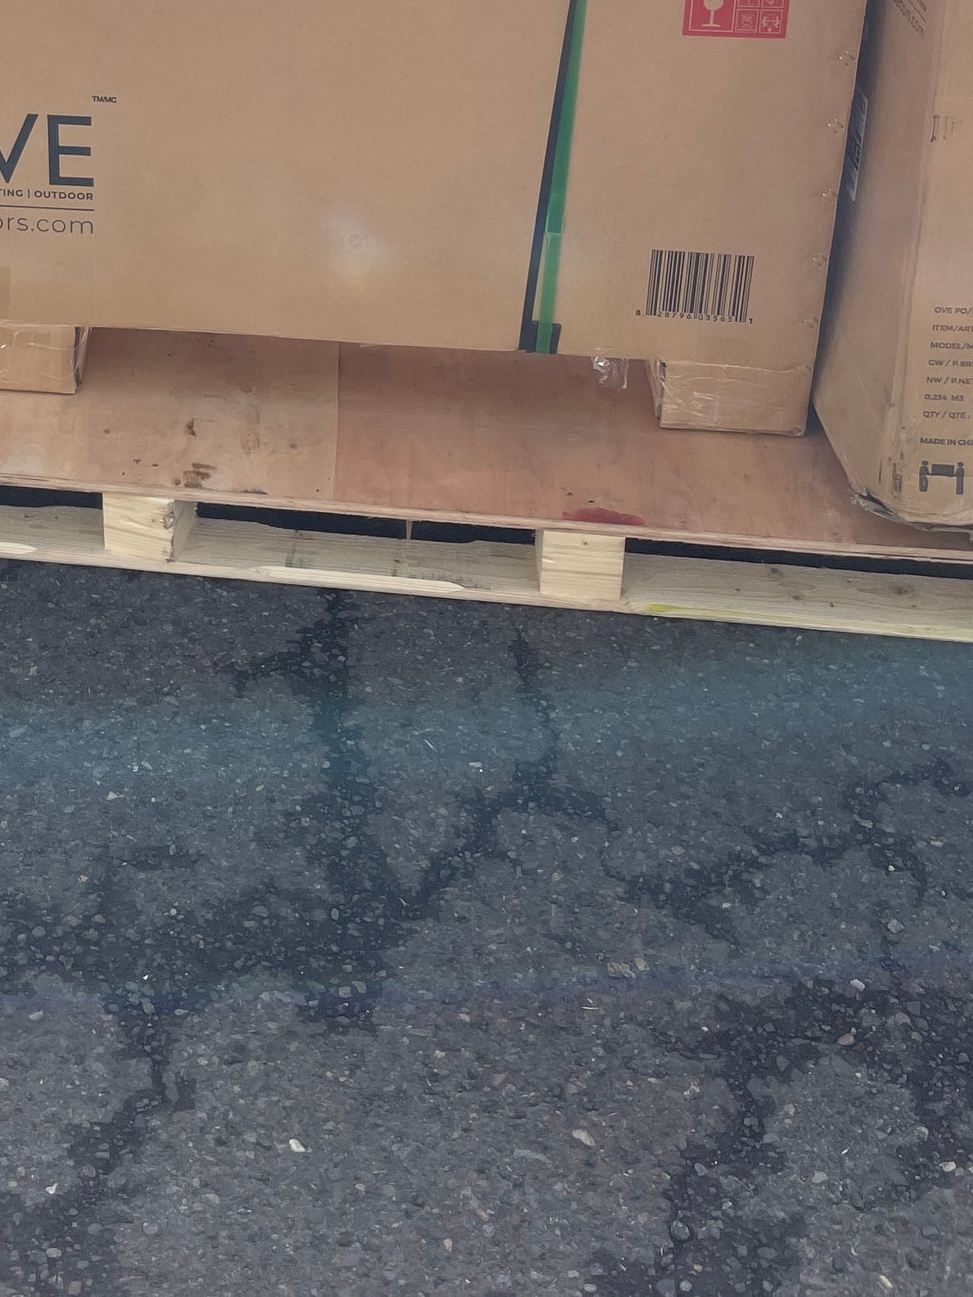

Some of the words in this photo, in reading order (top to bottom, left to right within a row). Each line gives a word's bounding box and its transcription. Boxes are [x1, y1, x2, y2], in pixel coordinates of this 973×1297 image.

[34, 190, 94, 201] OUTDOOR
[934, 306, 953, 314] OVE
[923, 410, 941, 419] QTY
[919, 437, 946, 445] MADE
[947, 438, 957, 446] IN
